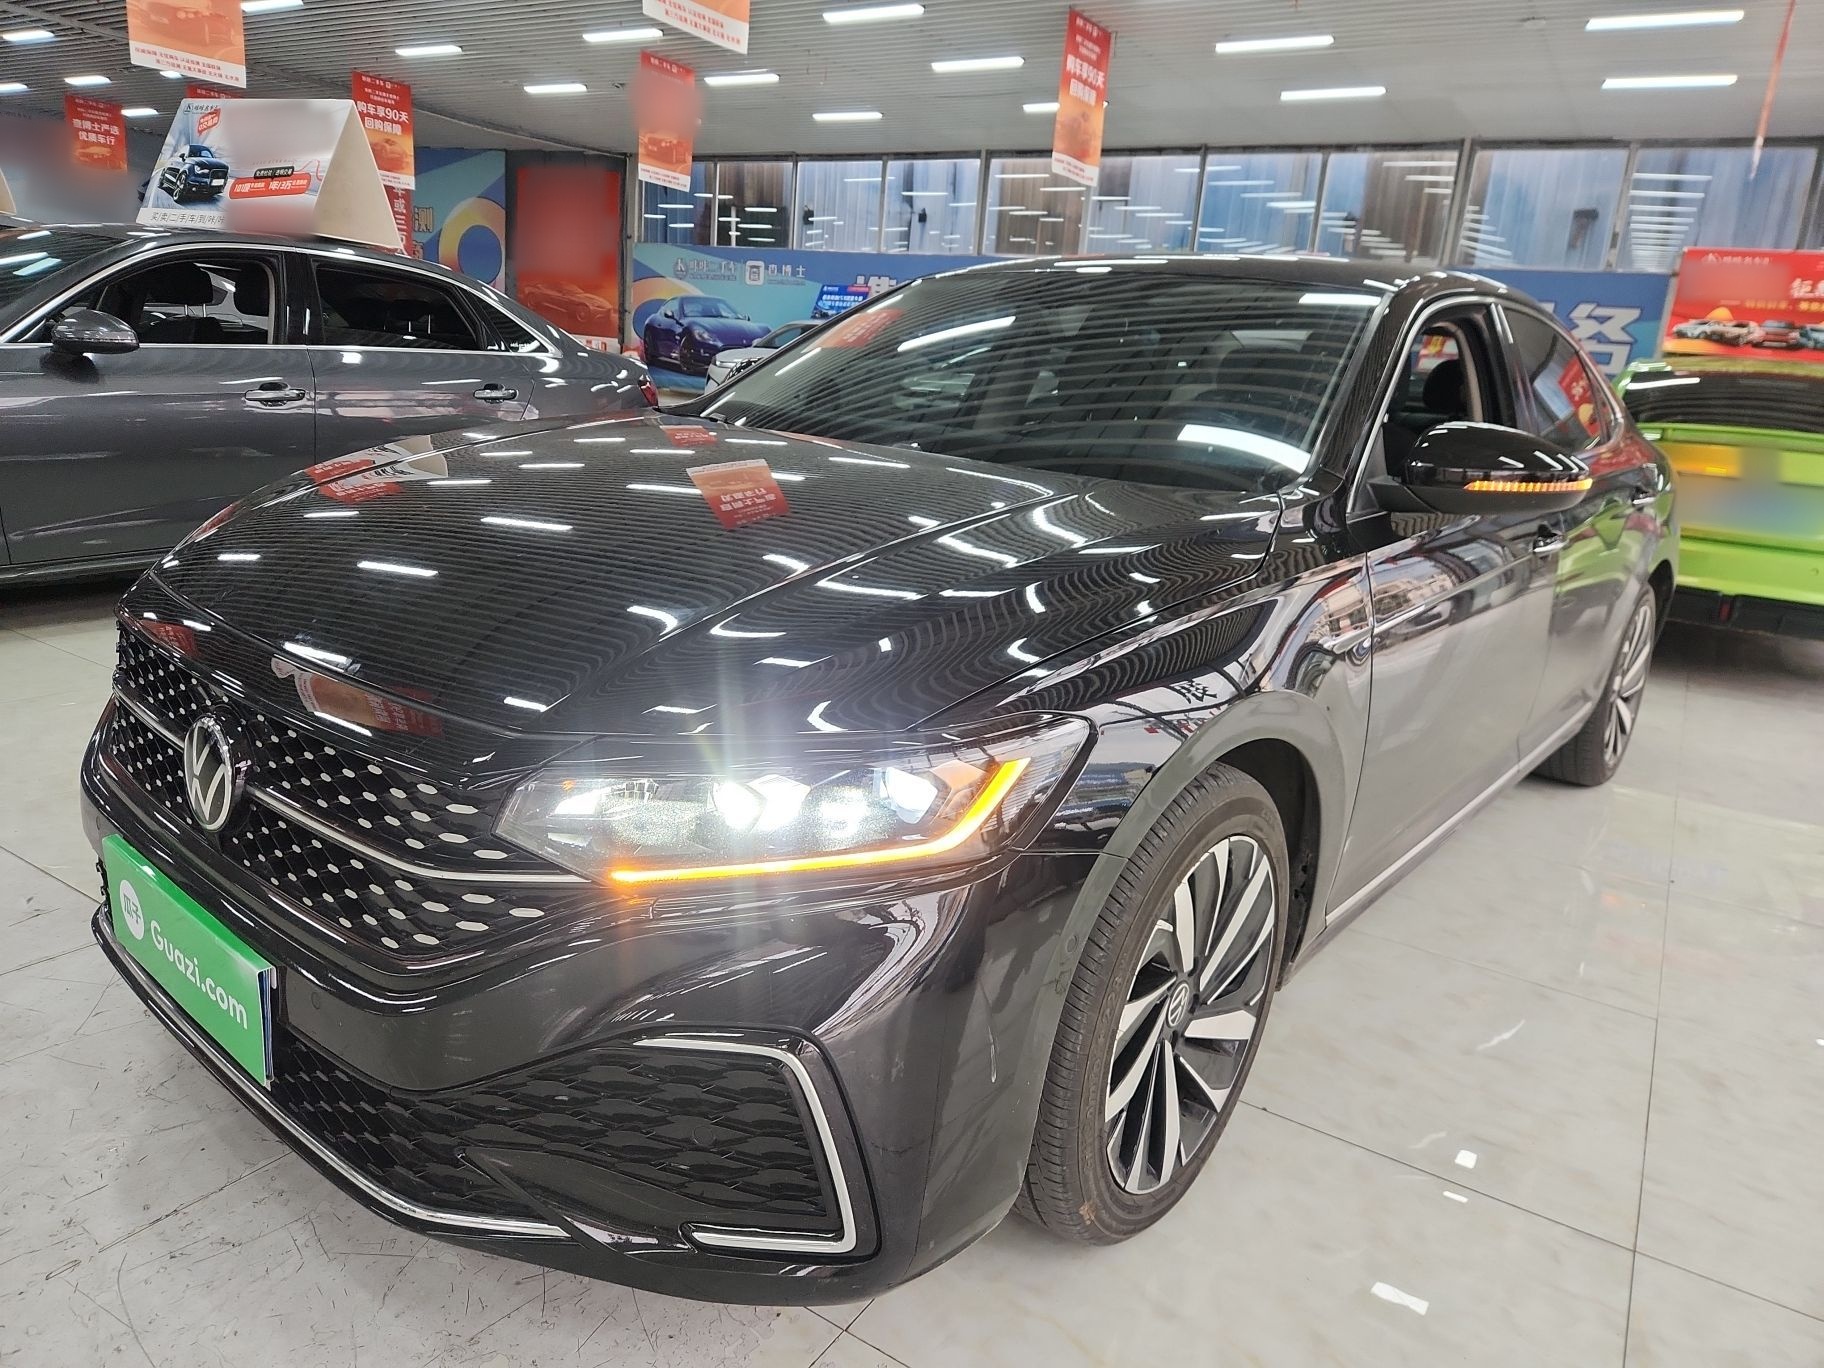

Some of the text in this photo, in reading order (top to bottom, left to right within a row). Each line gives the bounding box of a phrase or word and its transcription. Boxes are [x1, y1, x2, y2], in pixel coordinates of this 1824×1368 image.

[357, 100, 409, 123] 购车享90天
[72, 118, 120, 136] 查博士严选
[364, 116, 402, 136] 回购保障
[78, 130, 115, 146] 优质车行
[122, 892, 142, 926] 瓜子
[150, 919, 249, 1031] Guazi.com
